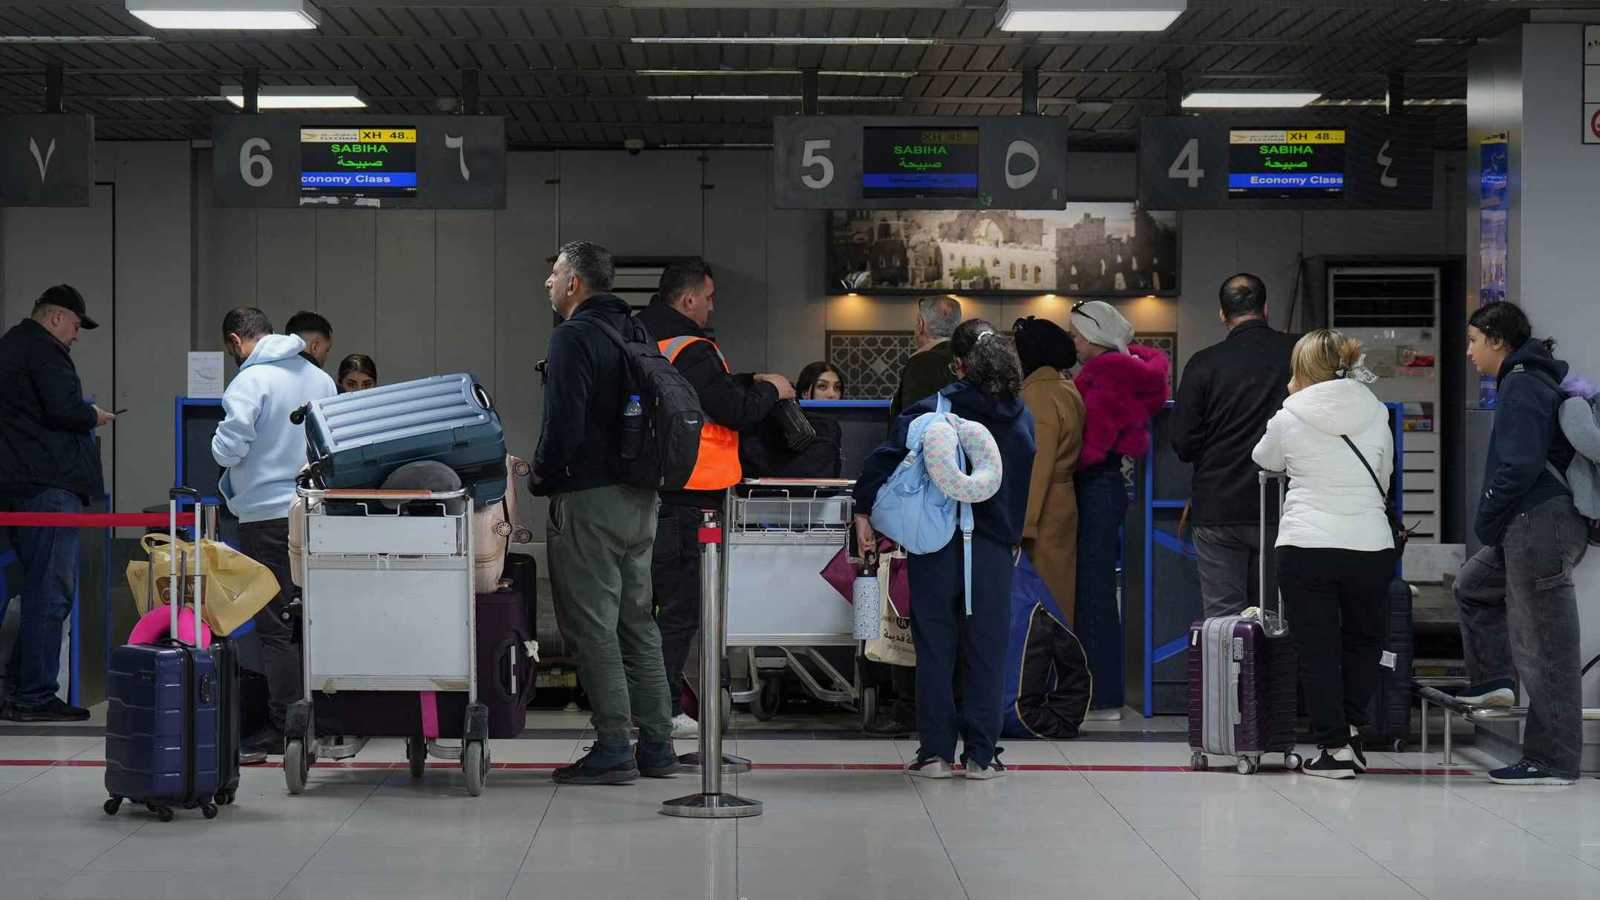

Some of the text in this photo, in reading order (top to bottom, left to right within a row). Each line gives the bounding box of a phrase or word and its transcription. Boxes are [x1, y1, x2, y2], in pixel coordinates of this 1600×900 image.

[362, 131, 382, 139] XH
[1290, 132, 1309, 141] XH
[330, 144, 389, 153] SABIHA
[893, 145, 947, 154] SABIHA
[1259, 145, 1314, 154] SABIHA
[29, 136, 57, 185] ٧
[239, 137, 273, 187] 6
[336, 155, 384, 169] صبيحة
[444, 134, 470, 181] ٦
[800, 139, 835, 190] 5
[898, 157, 943, 171] صبيحة
[1168, 138, 1205, 188] 4
[1263, 157, 1309, 170] صبيحة
[1376, 139, 1400, 188] ٤
[1003, 140, 1040, 190] ٥
[355, 174, 391, 183] Class
[1249, 175, 1344, 186] Economy Class
